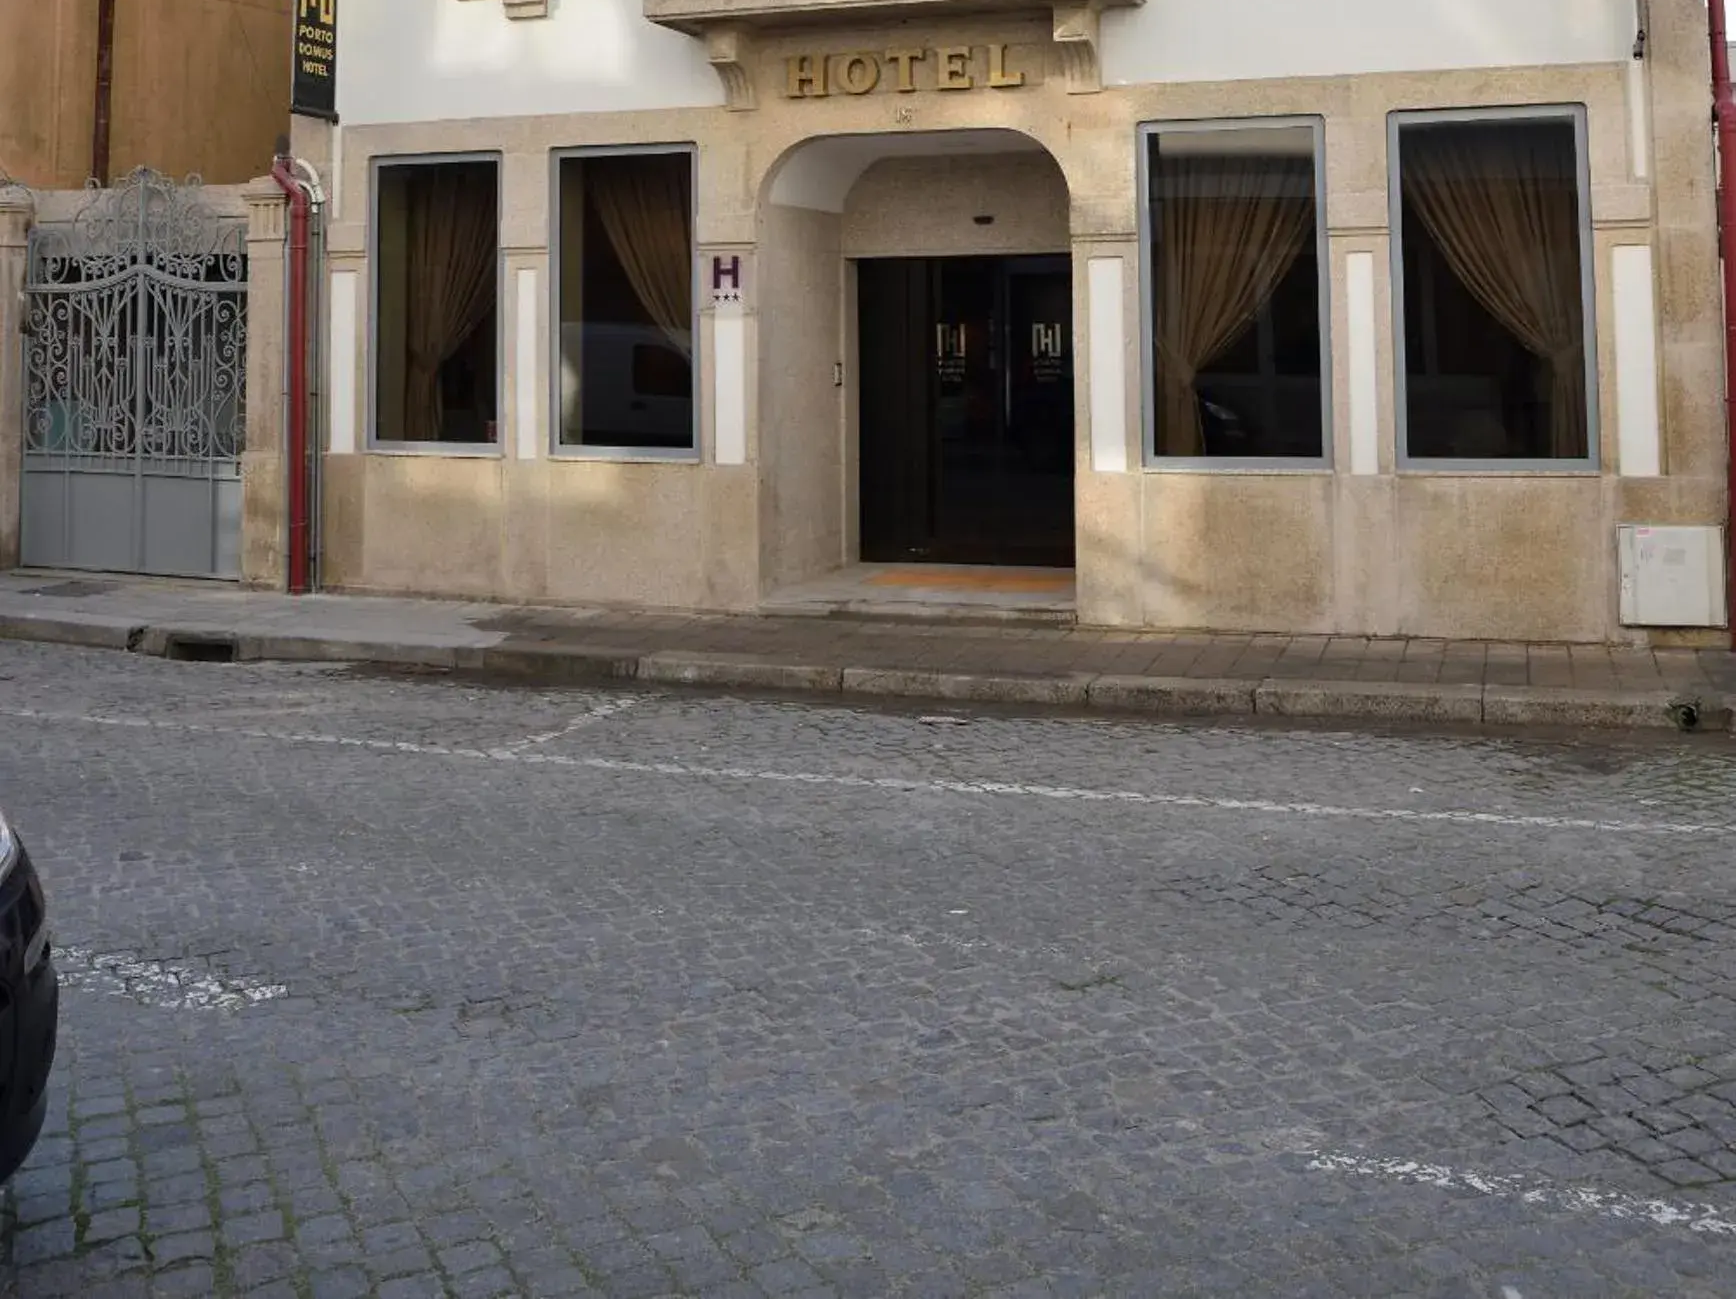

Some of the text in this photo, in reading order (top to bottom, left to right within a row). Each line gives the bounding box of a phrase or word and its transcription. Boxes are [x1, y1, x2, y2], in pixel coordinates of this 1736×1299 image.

[299, 25, 333, 43] PORTO
[299, 43, 333, 60] DOMUS
[302, 60, 328, 76] HOTEL
[786, 44, 1024, 98] HOTEL
[713, 255, 739, 290] H
